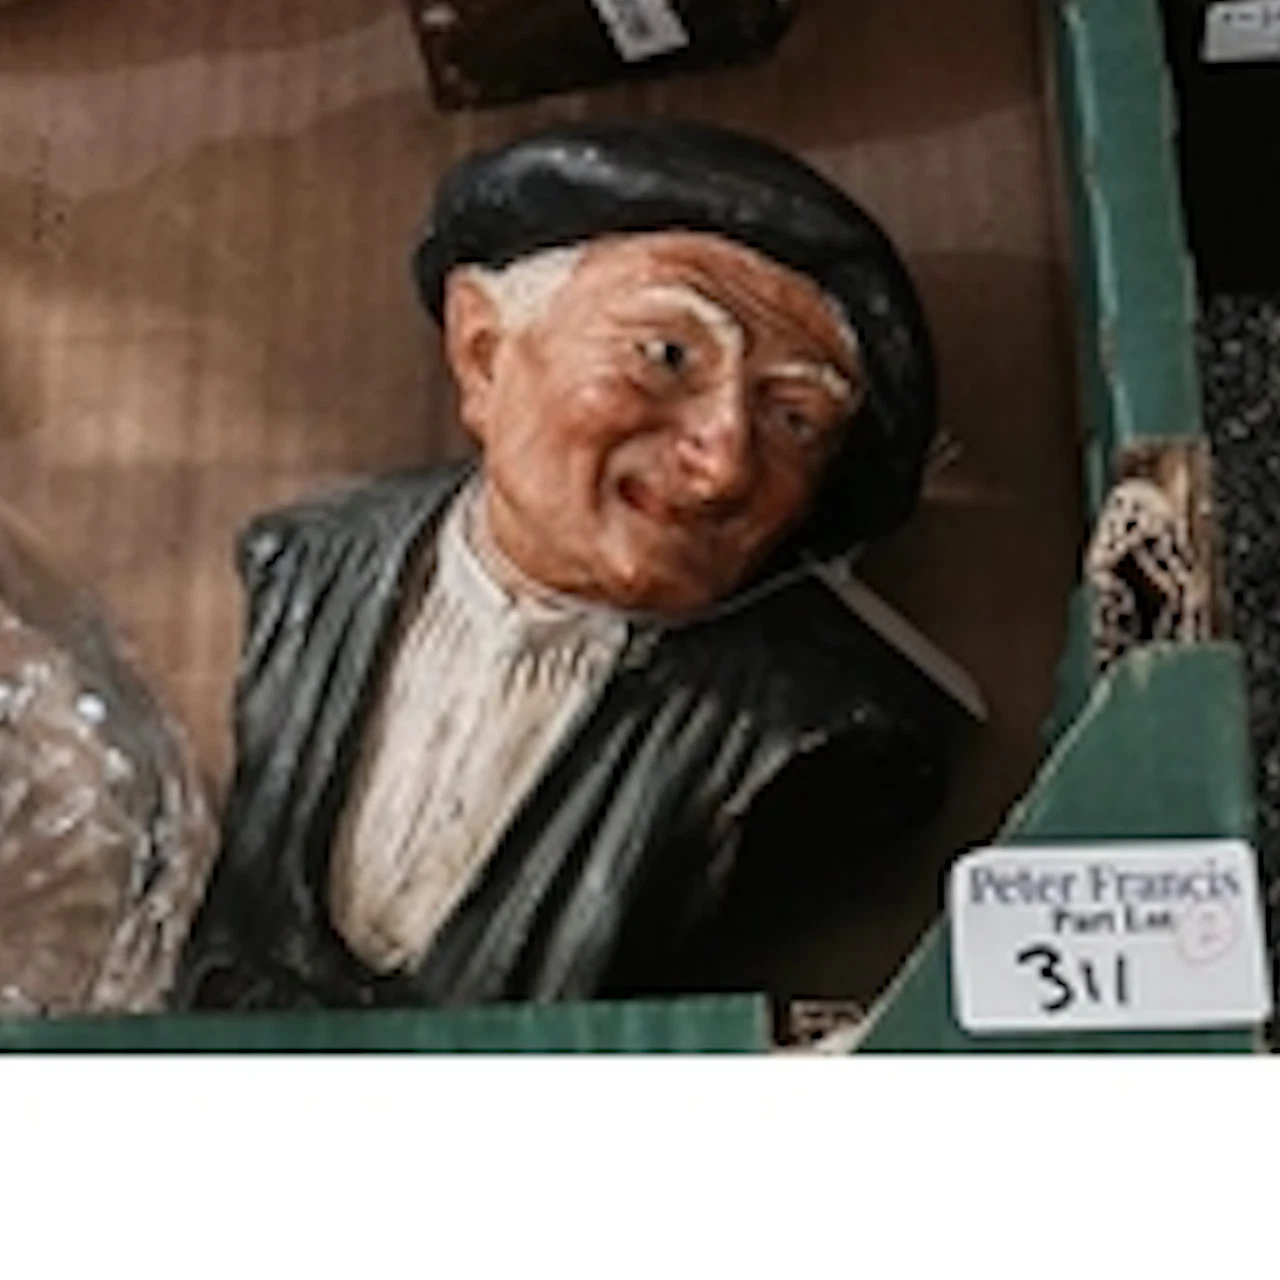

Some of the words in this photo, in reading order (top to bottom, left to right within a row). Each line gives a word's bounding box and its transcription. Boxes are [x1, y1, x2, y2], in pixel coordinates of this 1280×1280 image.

[970, 864, 1077, 906] Peter
[1087, 857, 1242, 905] Francis
[1016, 943, 1128, 1016] 311
